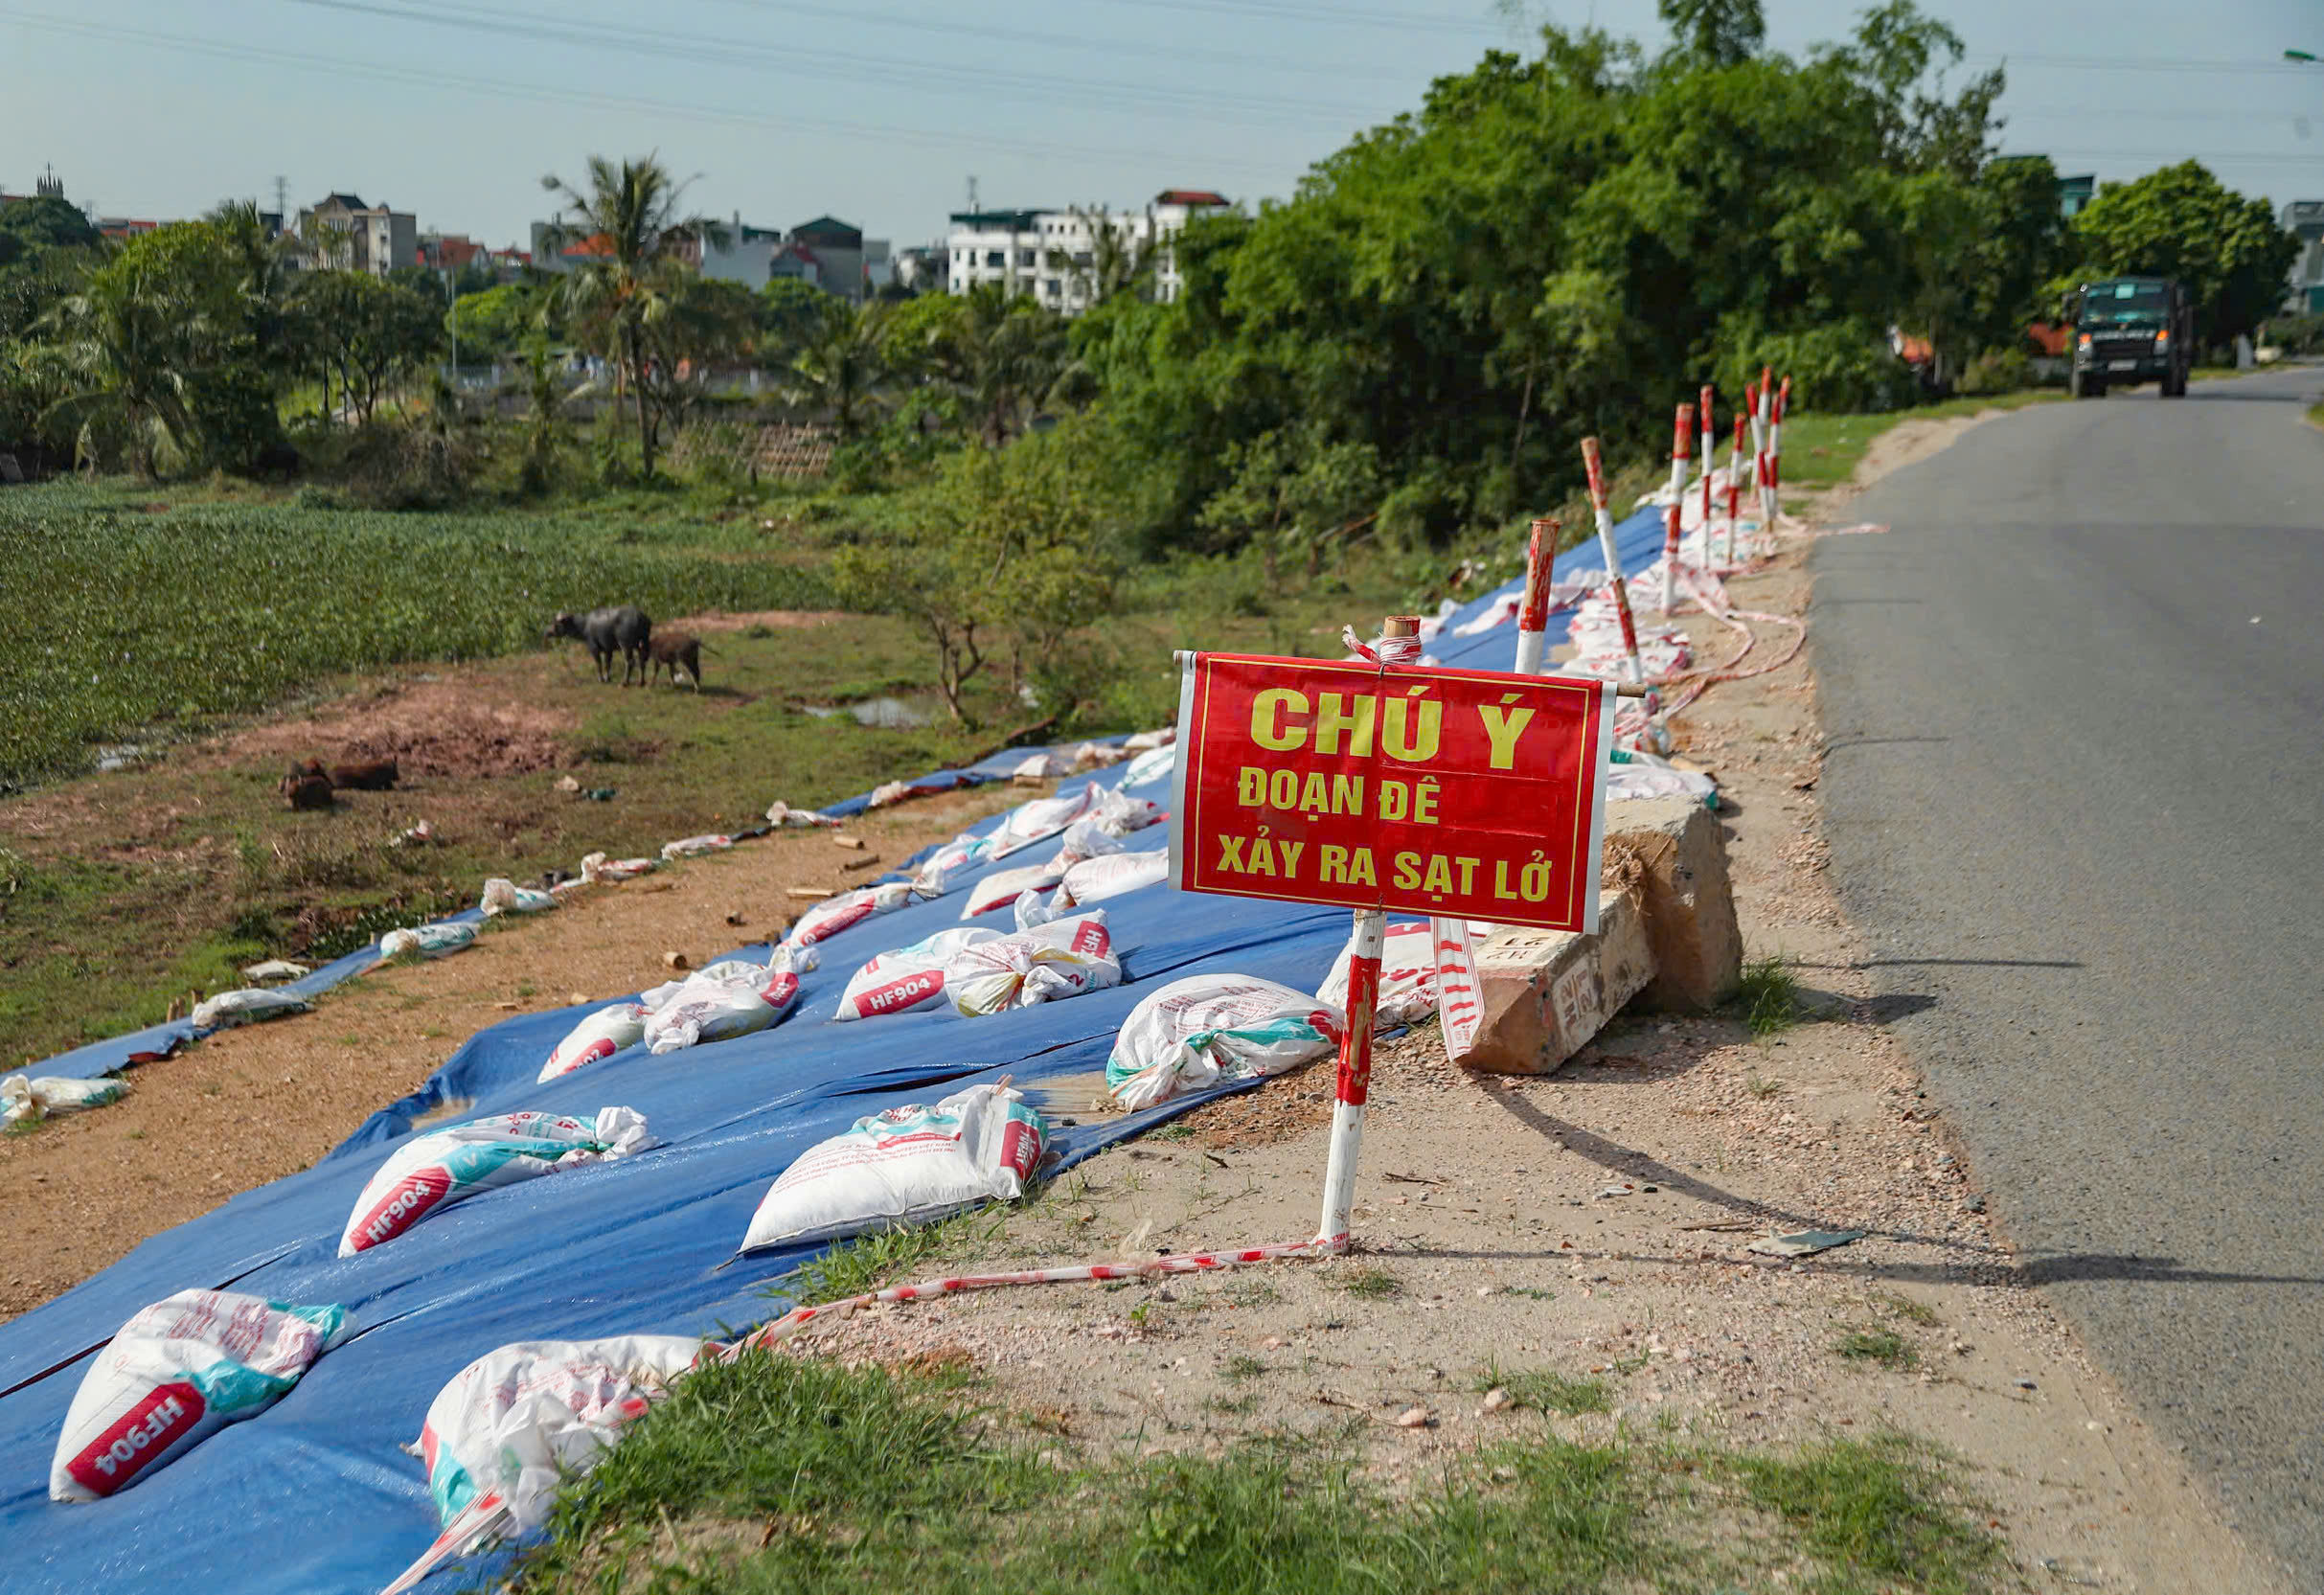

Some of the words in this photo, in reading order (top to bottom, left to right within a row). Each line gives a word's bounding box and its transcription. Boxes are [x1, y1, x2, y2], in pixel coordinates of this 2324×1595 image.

[1250, 684, 1444, 763] CHÚ
[1478, 692, 1537, 770] Ý
[1238, 765, 1365, 822] ĐOẠN
[1378, 773, 1442, 825] ĐÊ
[1216, 824, 1305, 878] XẢY
[1319, 844, 1378, 888] RA
[1393, 851, 1481, 902] SẠT
[1494, 848, 1552, 902] LỞ
[870, 976, 931, 1010] HF904
[365, 1180, 431, 1243] HF904
[95, 1396, 185, 1477] HF904
